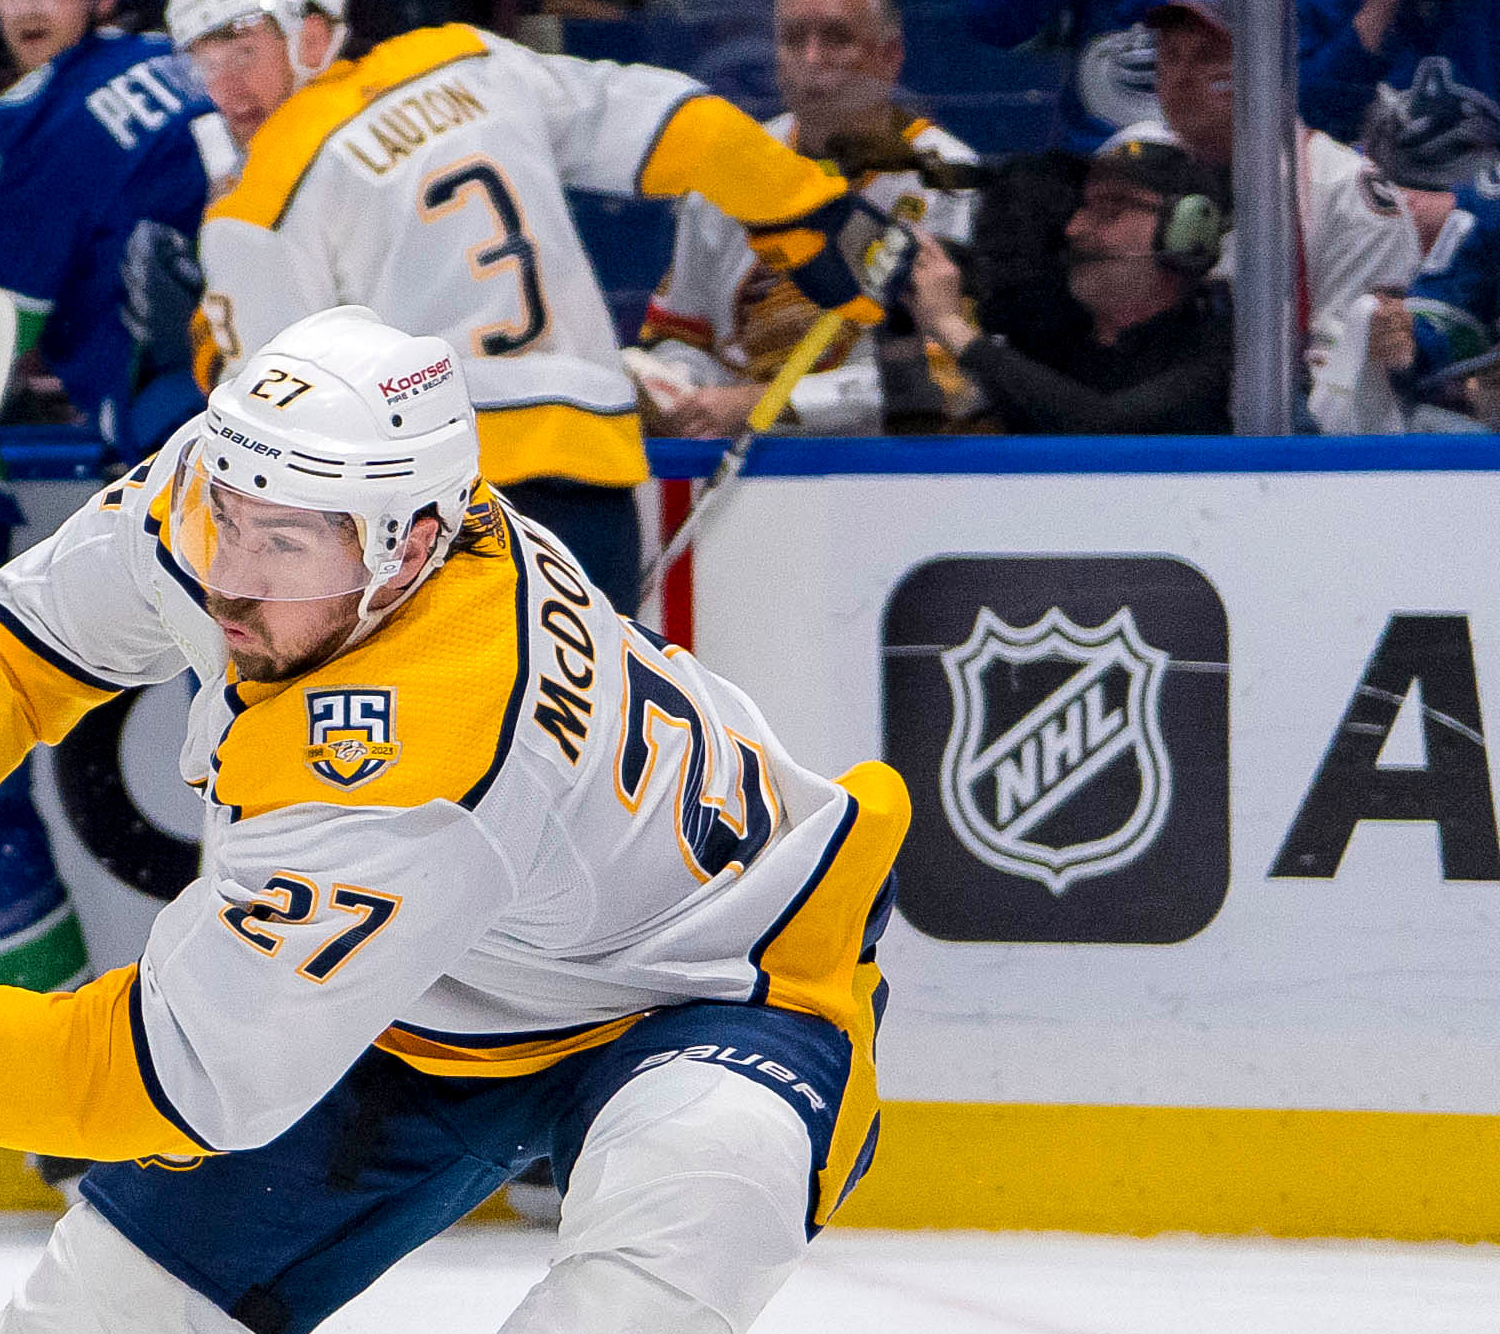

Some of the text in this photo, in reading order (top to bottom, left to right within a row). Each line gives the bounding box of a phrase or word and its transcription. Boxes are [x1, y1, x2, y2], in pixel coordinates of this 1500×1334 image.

[344, 79, 489, 176] LAUZON
[419, 154, 550, 359] 3
[249, 368, 315, 411] 27
[378, 356, 452, 398] Koorsen
[312, 694, 386, 745] 25
[371, 746, 394, 756] 2023
[994, 671, 1130, 826] NHL
[217, 869, 404, 986] 27
